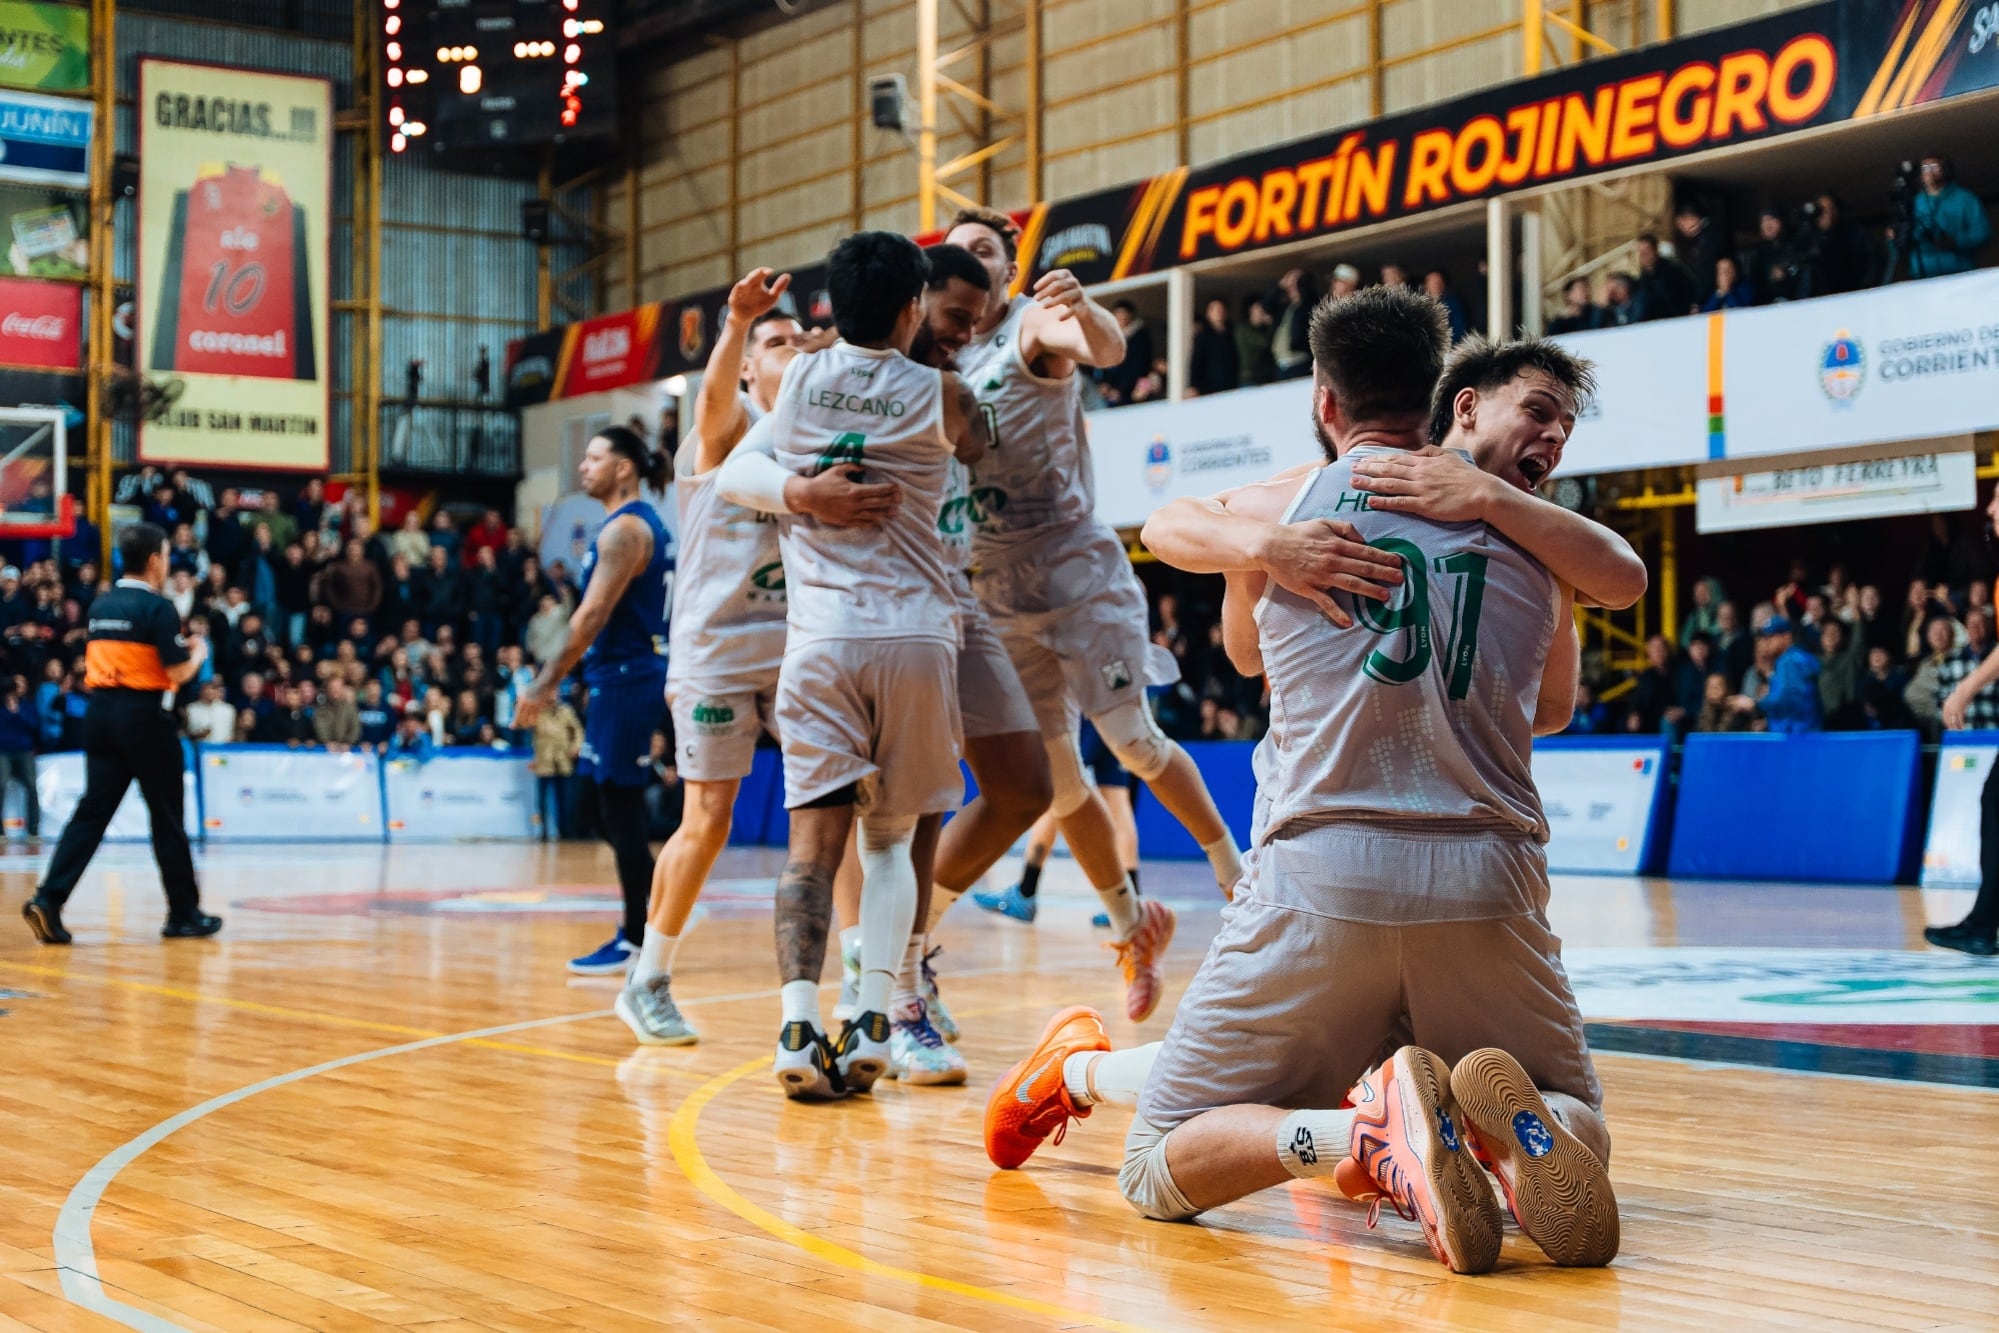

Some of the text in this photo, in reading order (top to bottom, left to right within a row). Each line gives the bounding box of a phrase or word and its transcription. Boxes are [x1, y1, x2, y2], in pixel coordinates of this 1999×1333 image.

[1180, 32, 1839, 260] FORTÍN ROJINEGRO
[203, 258, 267, 316] 10
[1880, 328, 1974, 355] GOBIERNO
[808, 388, 905, 418] LEZCANO
[1352, 537, 1488, 701] 91
[1461, 643, 1472, 667] LYON
